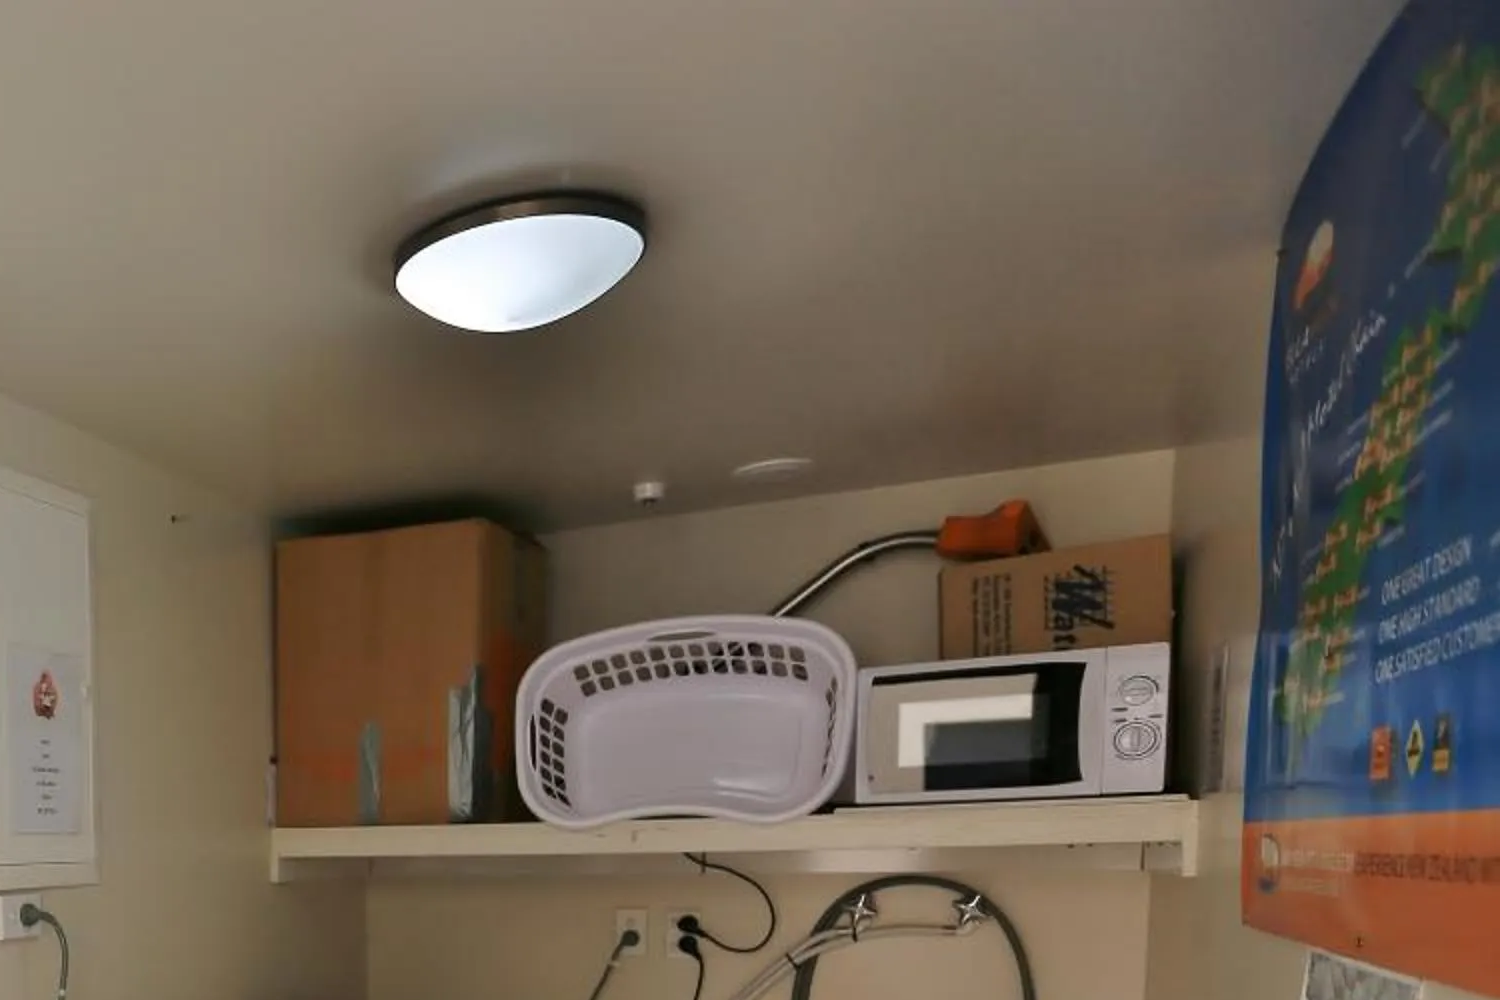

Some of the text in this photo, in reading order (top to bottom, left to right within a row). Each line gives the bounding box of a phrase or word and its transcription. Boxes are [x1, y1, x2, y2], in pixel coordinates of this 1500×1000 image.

[1381, 575, 1401, 605] ONE
[1431, 534, 1472, 579] DESIGN
[1378, 615, 1397, 644] ONE
[1421, 575, 1480, 625] STANDARD
[1374, 655, 1395, 684] ONE
